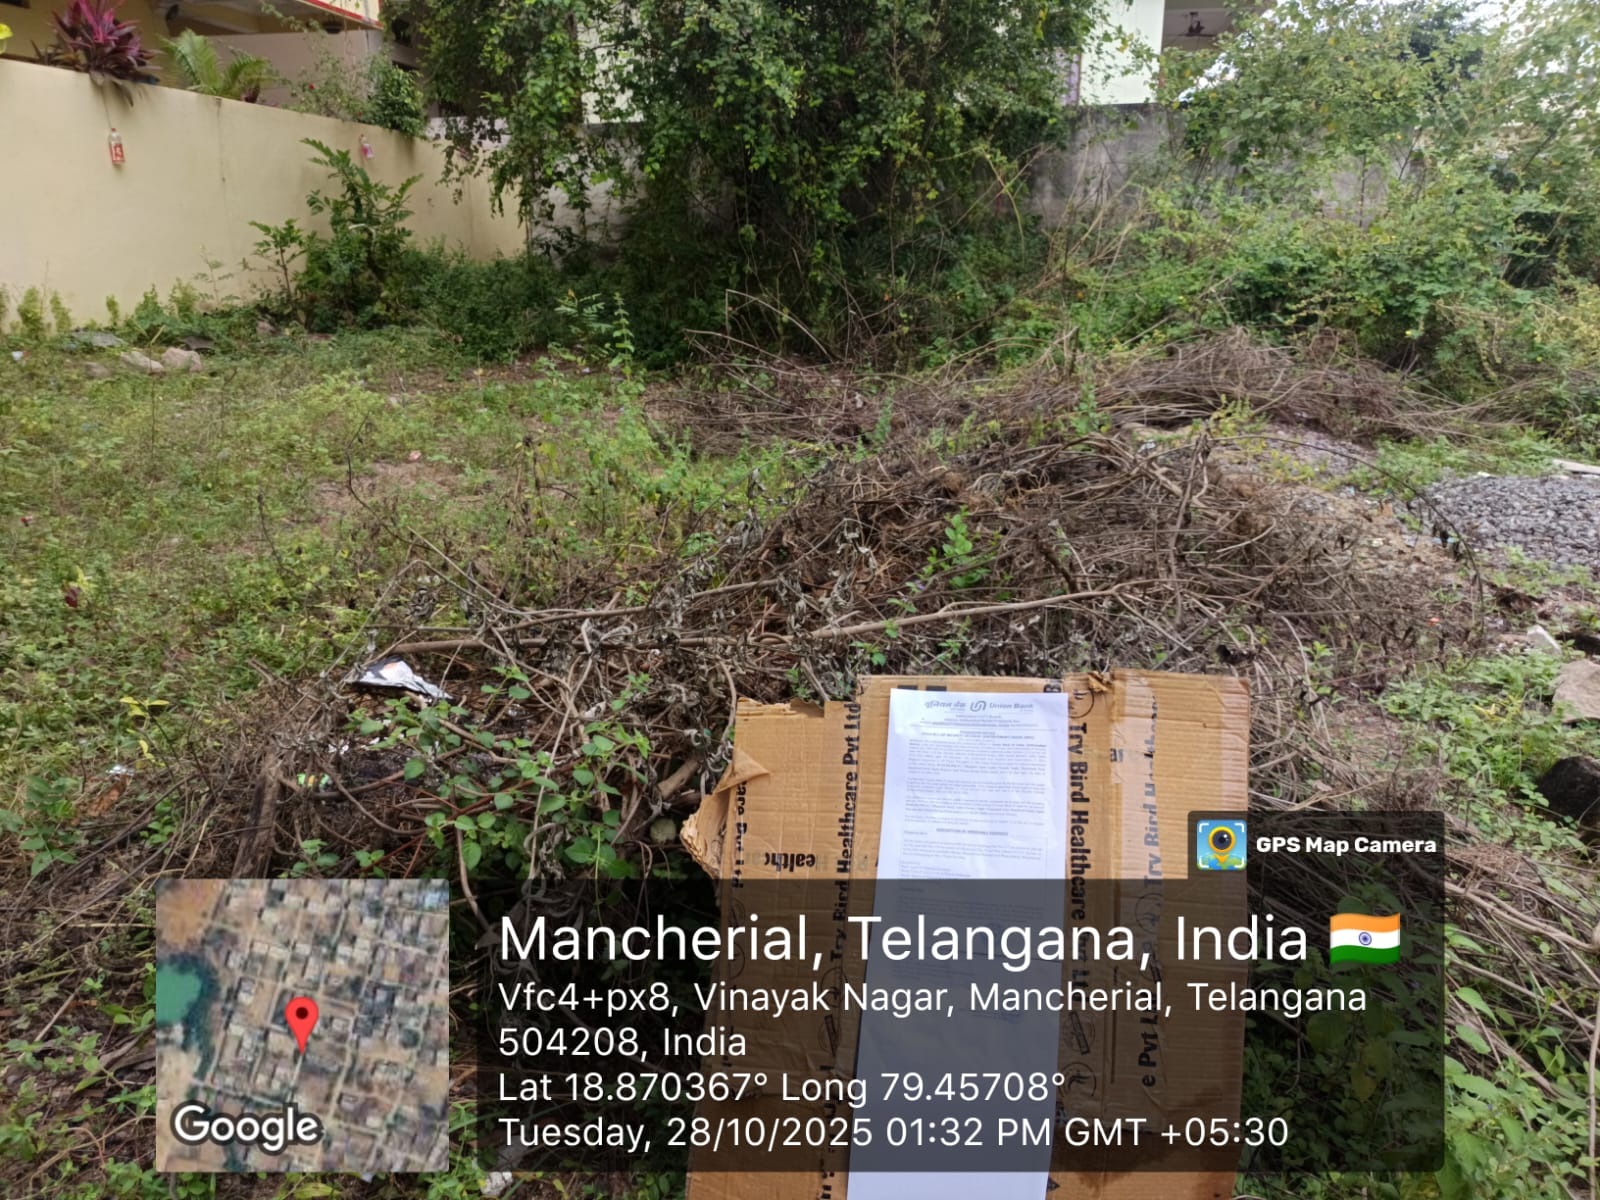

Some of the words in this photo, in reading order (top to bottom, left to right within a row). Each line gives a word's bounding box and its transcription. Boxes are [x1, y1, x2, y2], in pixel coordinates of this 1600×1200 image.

[844, 701, 861, 730] Ltd
[989, 701, 1012, 709] Union
[843, 736, 861, 766] Pvt
[1068, 722, 1088, 754] Try
[1070, 761, 1090, 804] Bird
[837, 772, 858, 873] Healthcare
[1070, 810, 1092, 920] Healthcare
[1144, 854, 1162, 888] Try
[832, 880, 849, 923] Bird
[829, 928, 847, 962] Try
